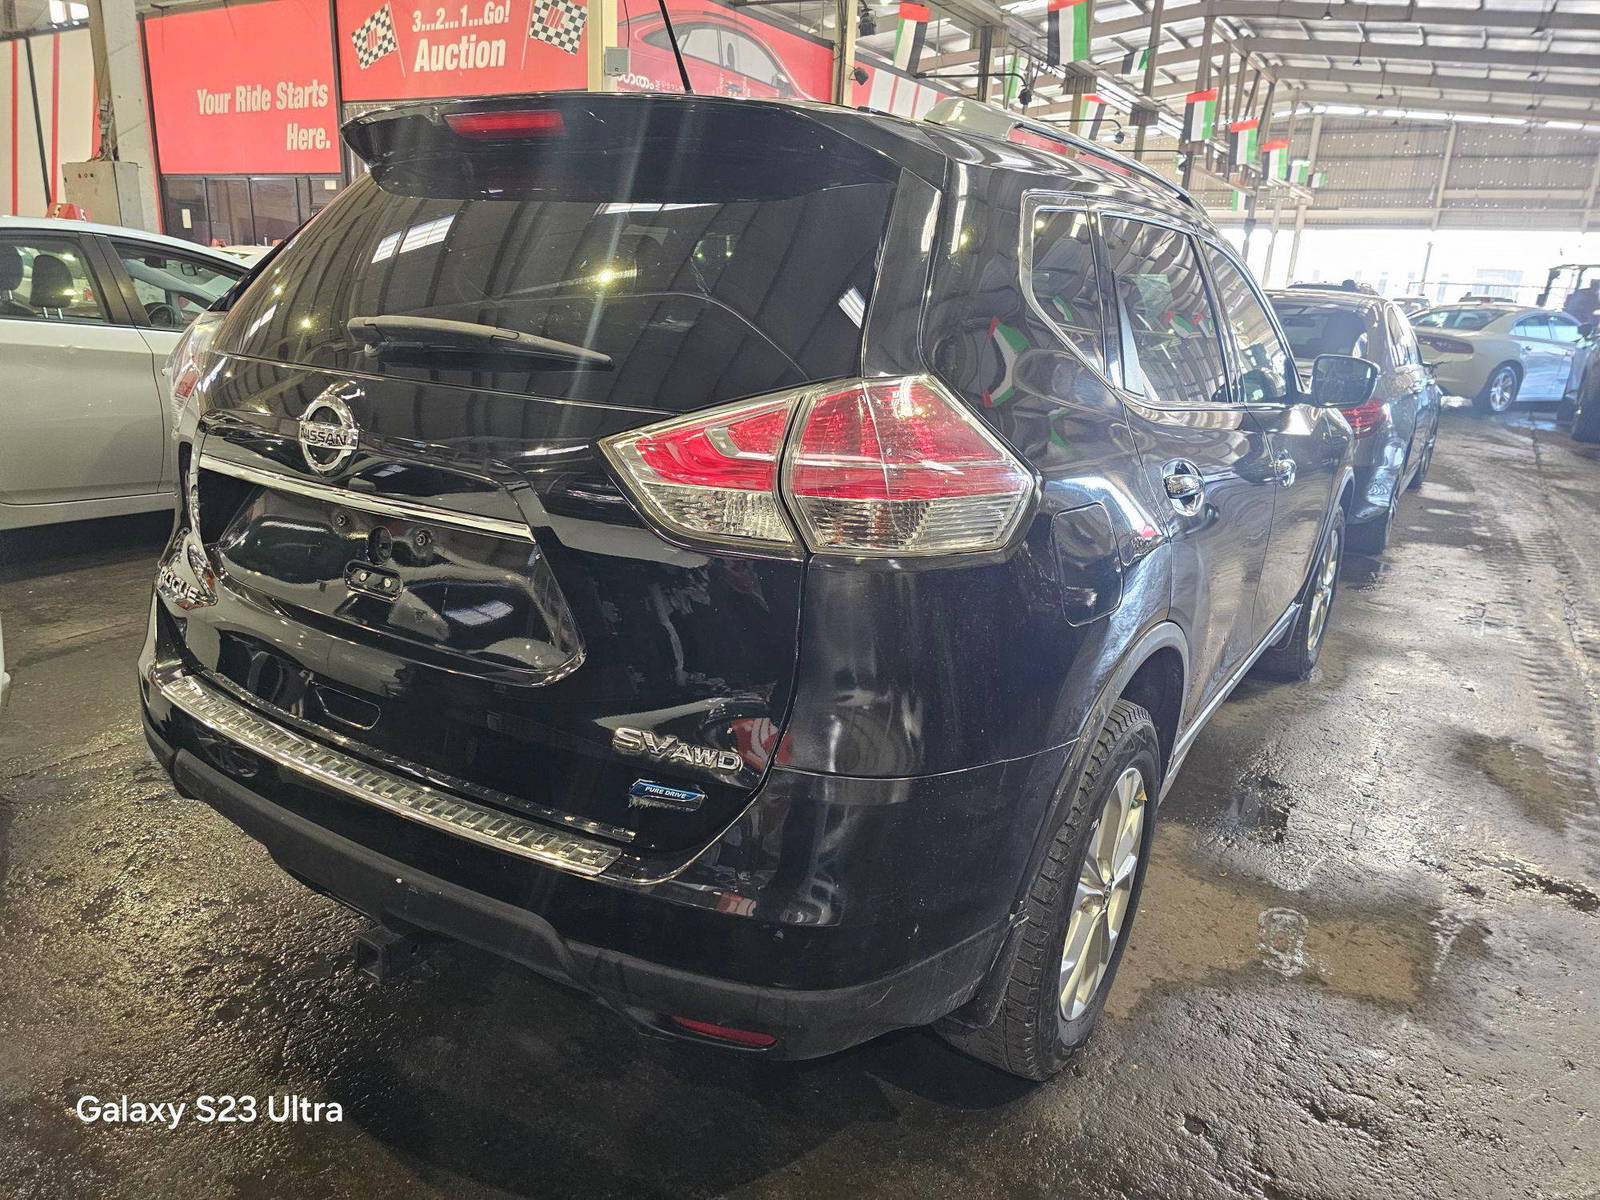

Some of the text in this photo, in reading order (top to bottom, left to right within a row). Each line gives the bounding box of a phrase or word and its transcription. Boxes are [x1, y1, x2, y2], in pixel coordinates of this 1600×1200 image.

[413, 33, 507, 73] Auction
[197, 79, 329, 115] Your Ride Starts
[286, 123, 331, 151] Here.
[300, 427, 347, 446] NISSAN
[612, 727, 743, 771] SV AWD
[644, 785, 687, 800] PURE DRIVE
